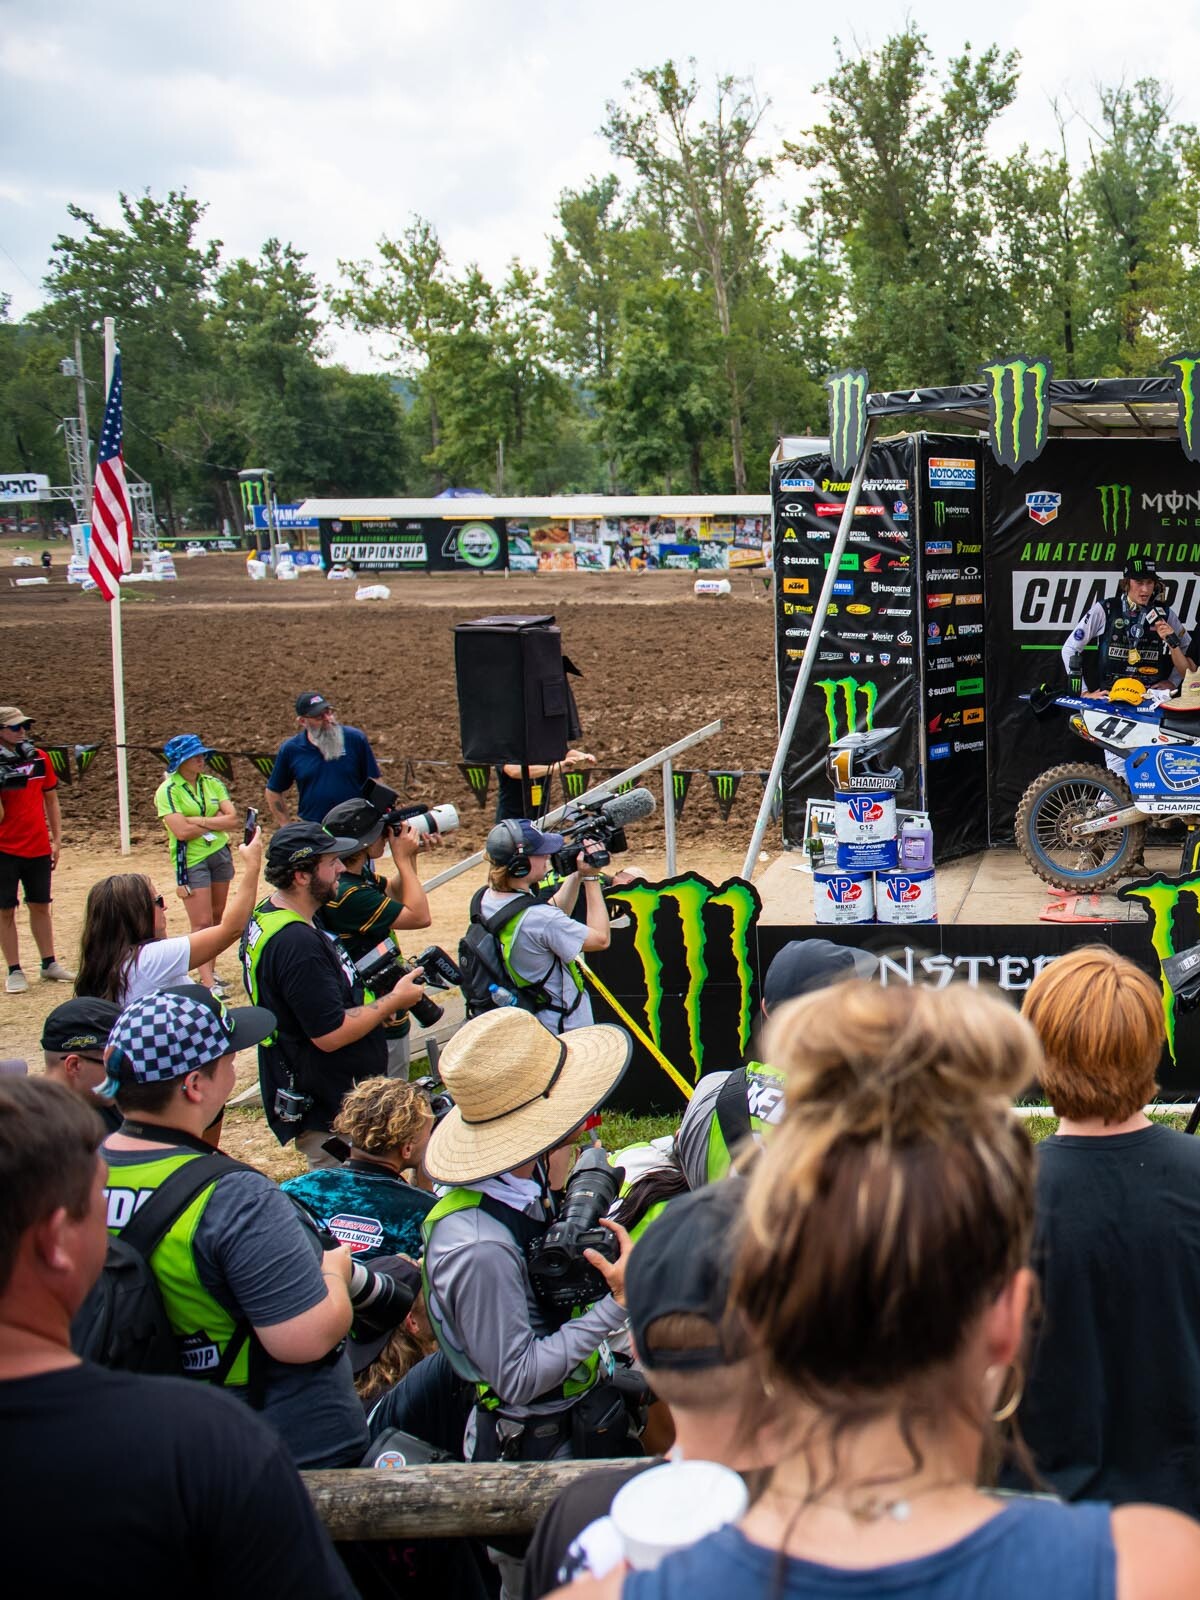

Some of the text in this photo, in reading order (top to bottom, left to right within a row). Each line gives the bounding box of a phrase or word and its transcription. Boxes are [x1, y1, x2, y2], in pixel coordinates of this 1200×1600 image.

[929, 468, 976, 479] MOTOCROSS
[781, 479, 813, 487] PARTS
[333, 545, 423, 559] CHAMPIONSHIP
[1020, 542, 1116, 562] AMATEUR
[790, 557, 819, 565] SUZUKI
[879, 584, 911, 593] Husqvarna
[933, 686, 956, 696] SUZUKI
[850, 776, 897, 789] CHAMPION
[848, 796, 873, 823] VP
[826, 876, 852, 903] VP
[886, 876, 911, 903] VP
